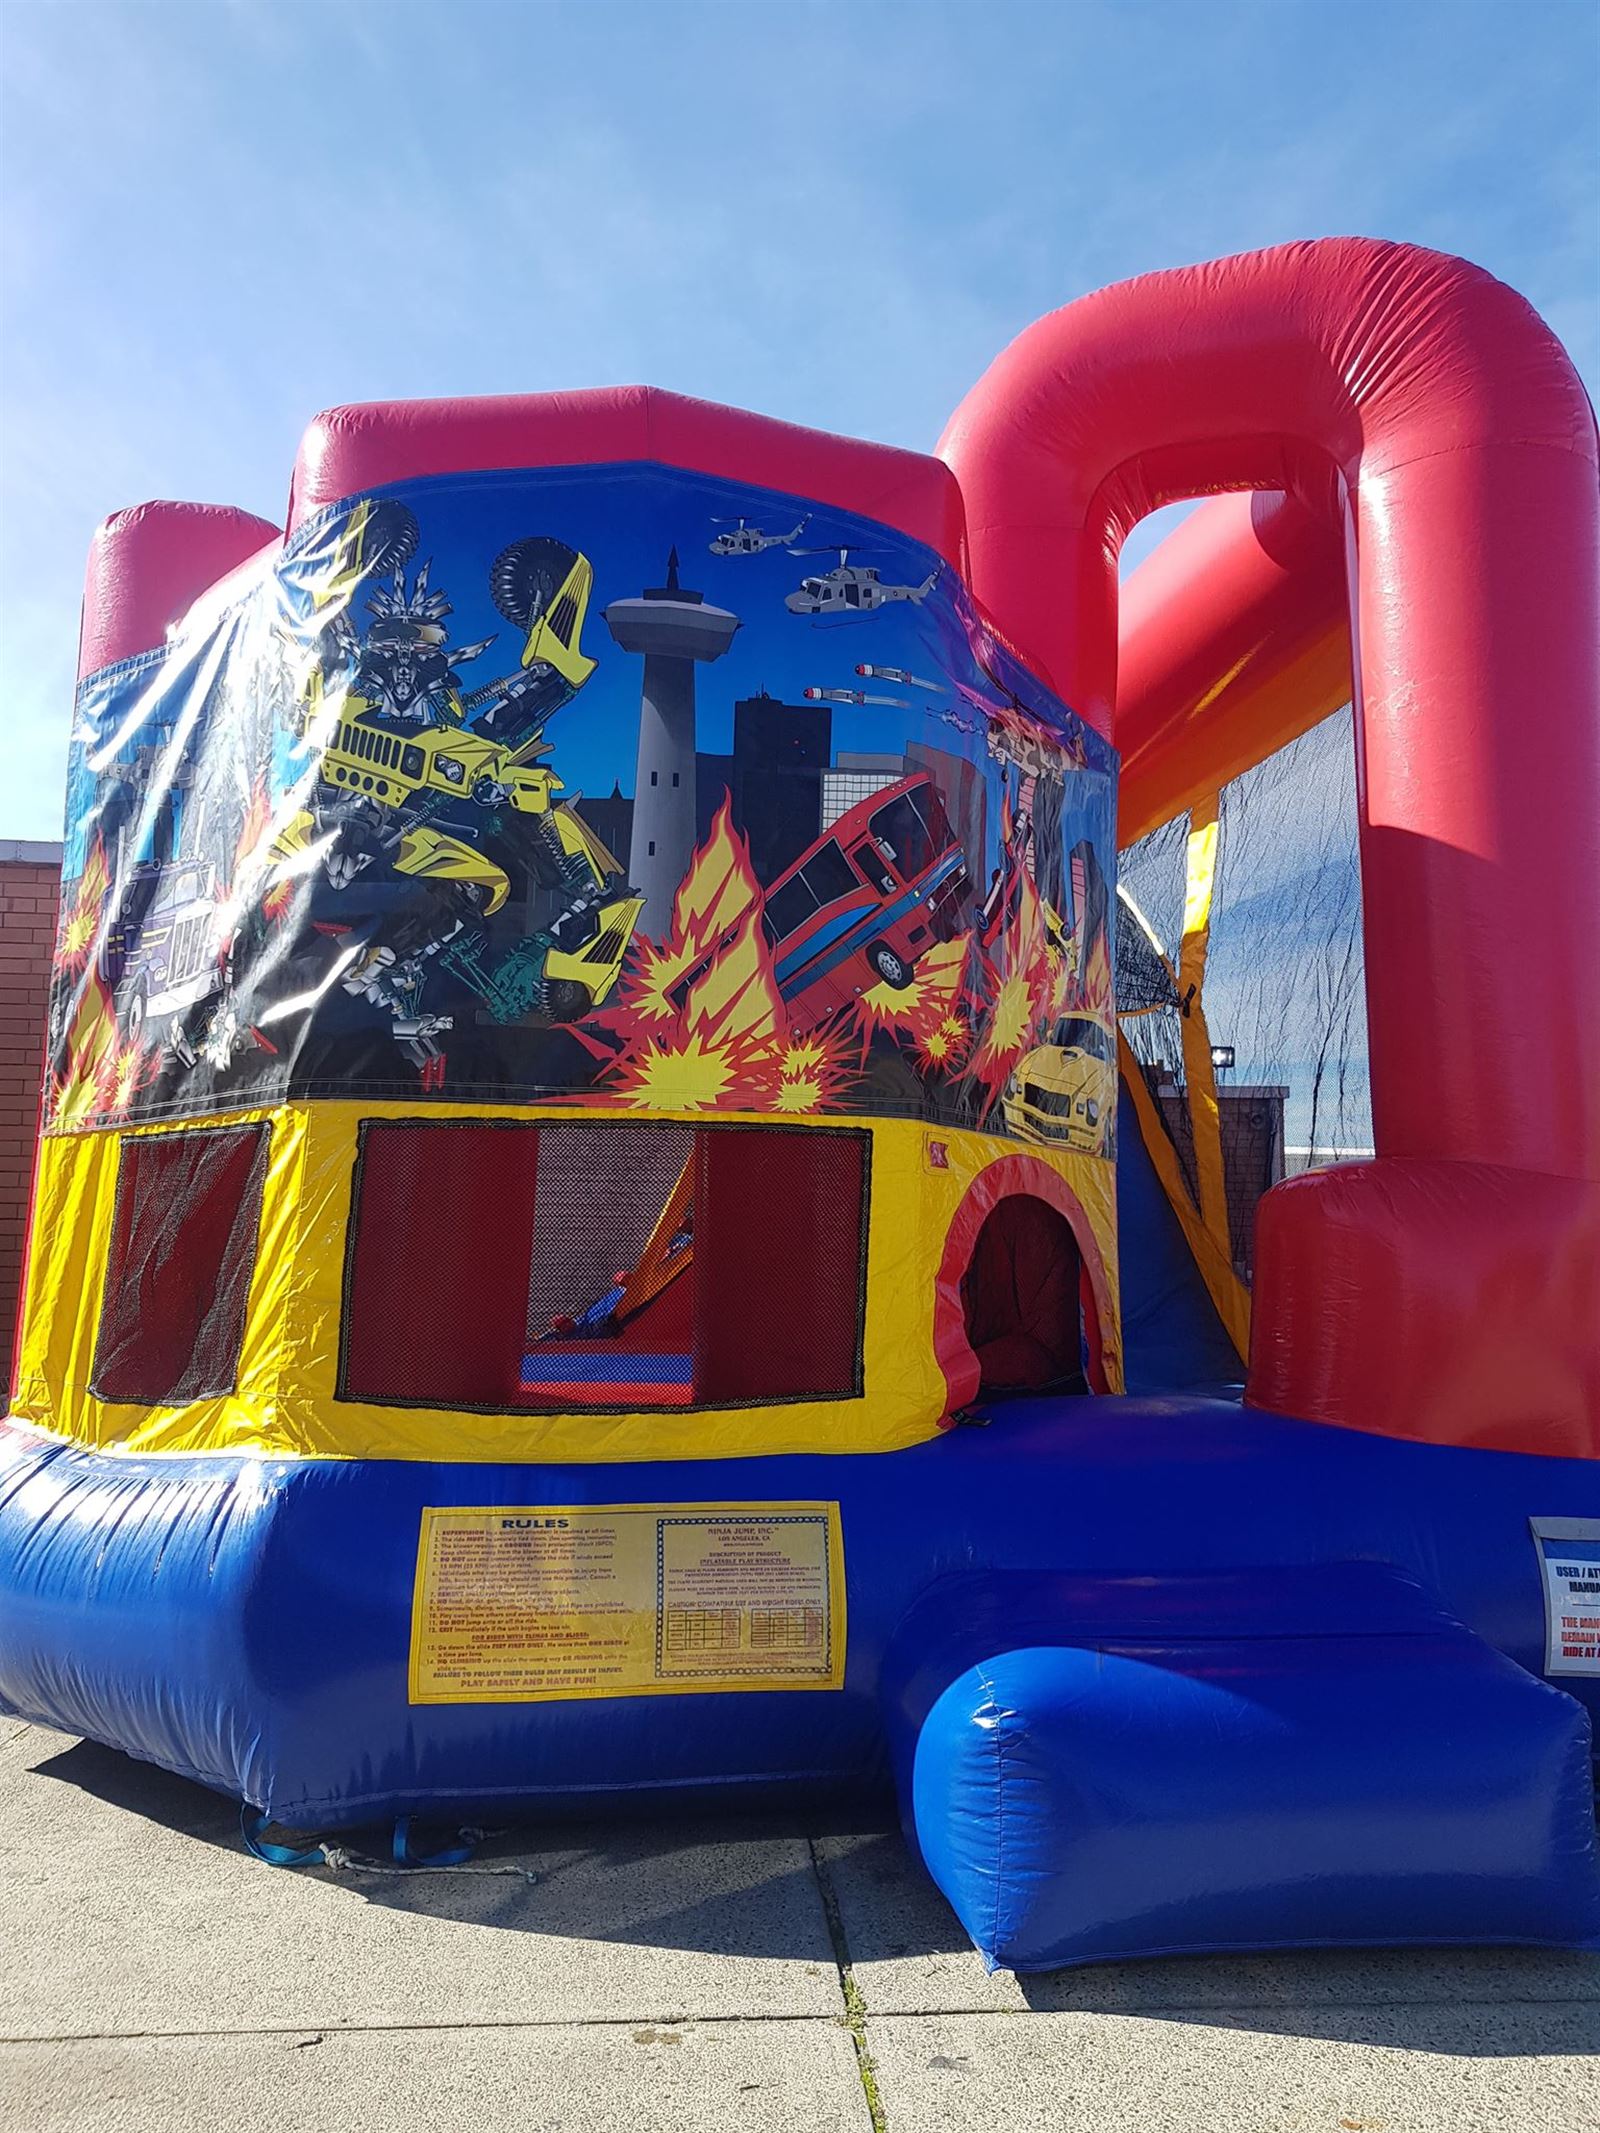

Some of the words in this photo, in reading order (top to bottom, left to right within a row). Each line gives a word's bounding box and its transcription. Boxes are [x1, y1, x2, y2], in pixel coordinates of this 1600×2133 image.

[502, 1519, 569, 1528] RULES
[1556, 1566, 1580, 1578] USER
[1561, 1616, 1579, 1628] THE
[1561, 1632, 1596, 1643] REMAIN
[1563, 1646, 1584, 1657] RIDE
[1584, 1647, 1597, 1658] AT
